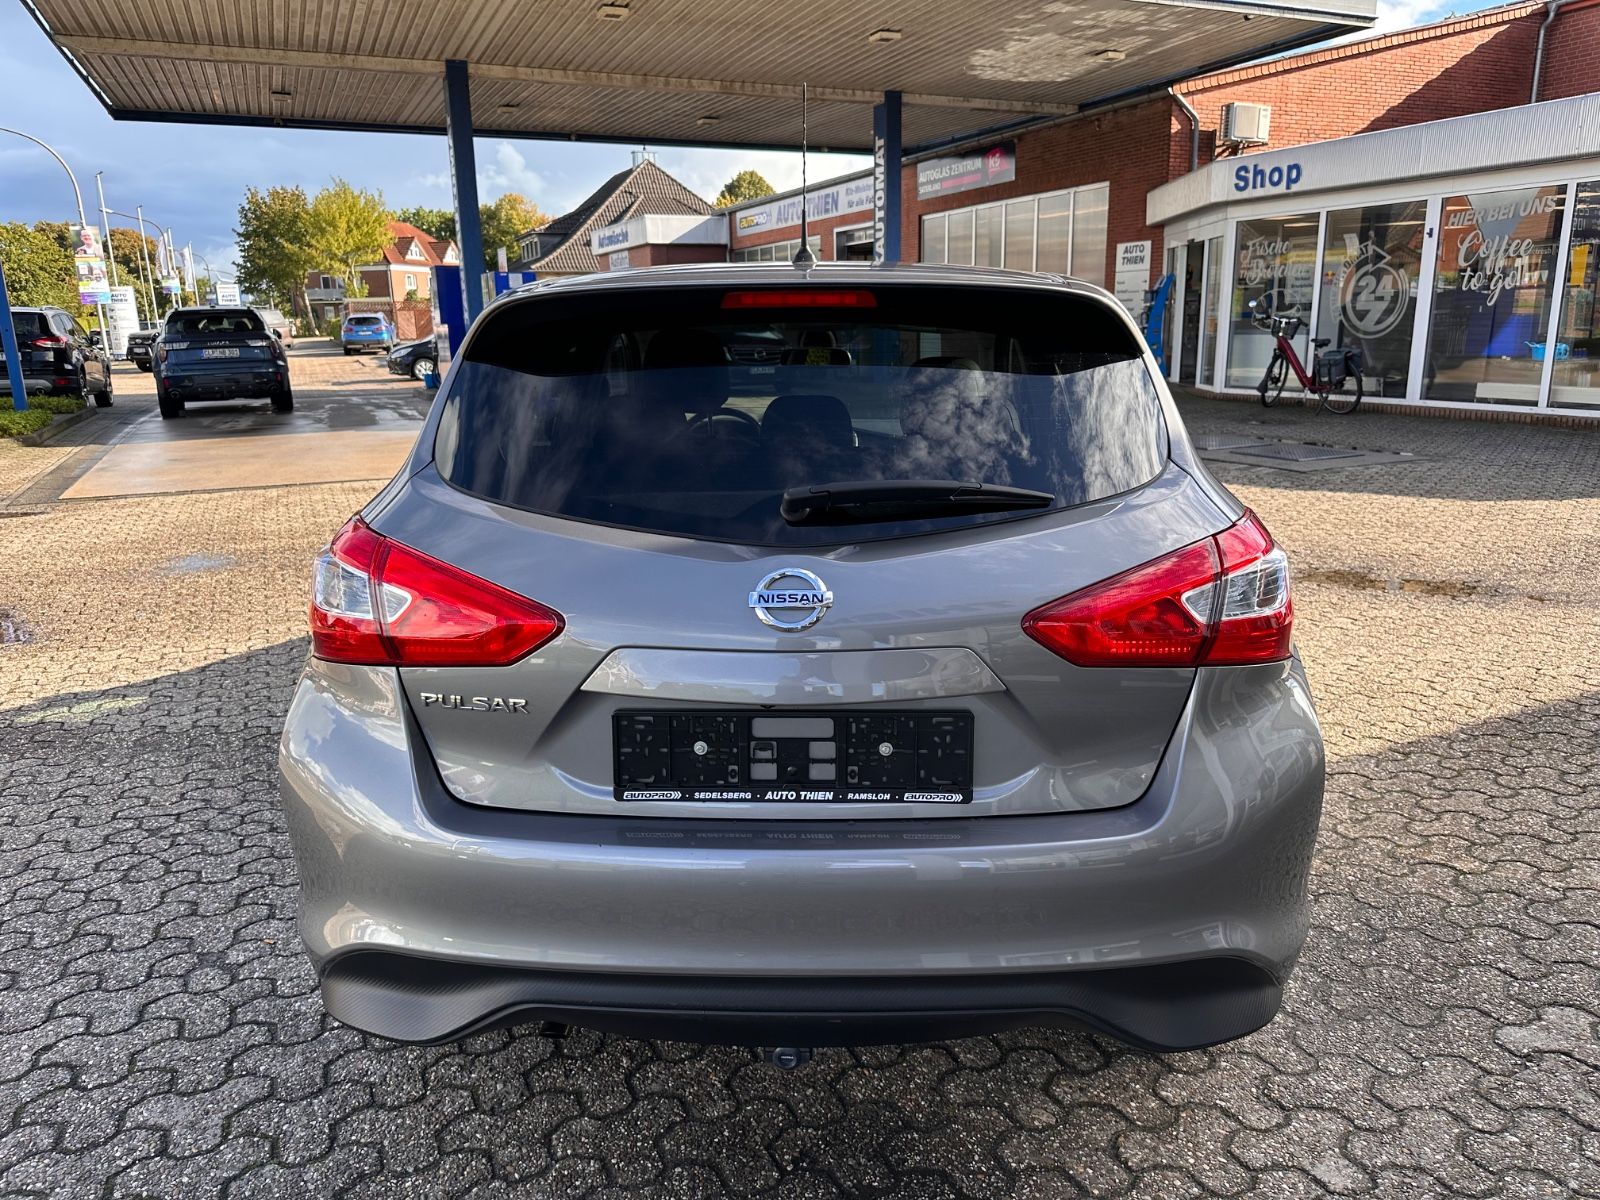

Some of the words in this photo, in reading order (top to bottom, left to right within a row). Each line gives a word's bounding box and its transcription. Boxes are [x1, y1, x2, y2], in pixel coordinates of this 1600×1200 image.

[1234, 163, 1302, 192] Shop
[776, 200, 804, 225] AUTO
[806, 191, 840, 219] THIEN
[1449, 209, 1486, 227] HIER
[1487, 205, 1515, 222] BEI
[1520, 198, 1557, 217] UNS
[1121, 256, 1145, 266] THIEN
[1123, 244, 1145, 255] AUTO
[1241, 235, 1290, 266] Frische
[1457, 229, 1534, 275] Coffee
[1357, 274, 1395, 302] 24
[1460, 267, 1485, 291] to
[756, 593, 824, 604] NISSAN
[420, 692, 530, 714] PULSAR
[693, 791, 752, 799] SEDELSBERG
[764, 791, 797, 800] AUTO
[799, 791, 834, 800] THIEN
[847, 792, 891, 800] RAMSLOH
